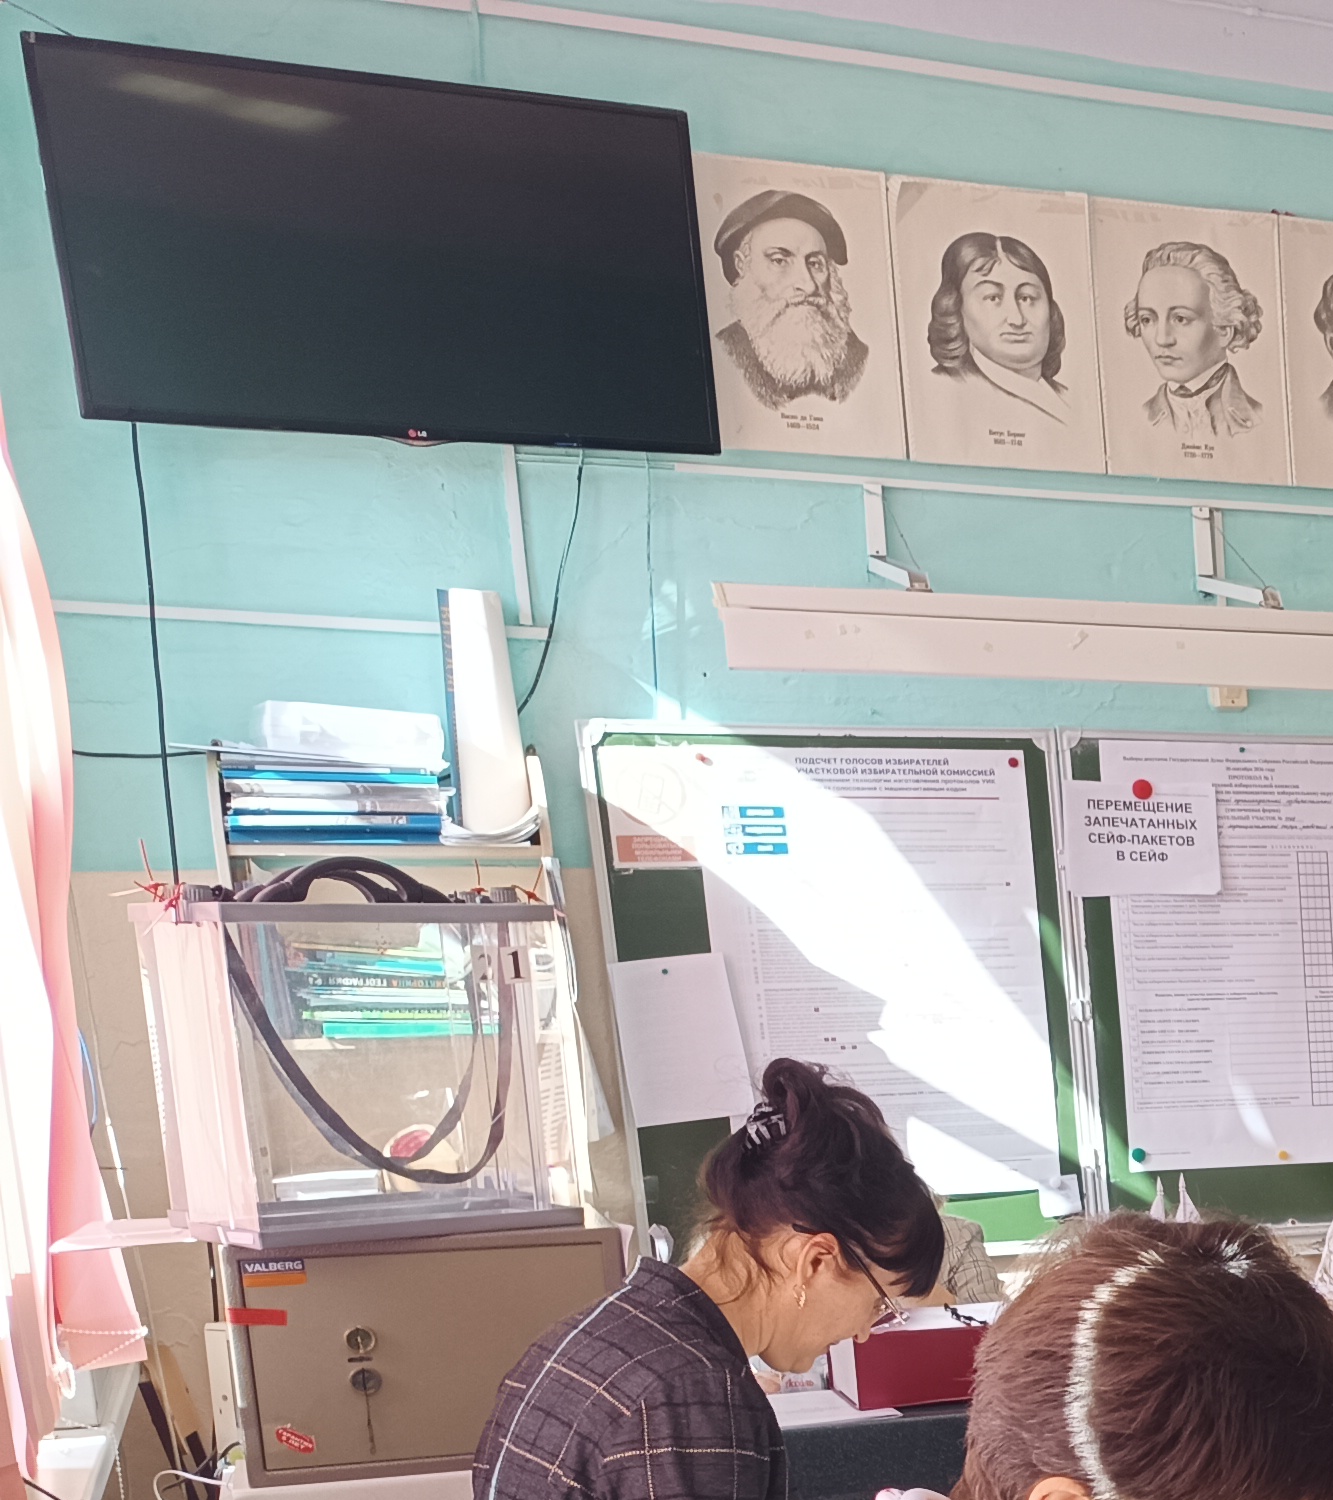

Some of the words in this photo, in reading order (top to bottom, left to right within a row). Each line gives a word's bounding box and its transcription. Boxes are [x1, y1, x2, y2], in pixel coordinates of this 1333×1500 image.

[795, 757, 837, 765] ПОДСЧЕТ
[886, 758, 949, 766] ИЗБИРАТЕЛЕЙ
[797, 767, 858, 775] УЧАСТКОВОЙ
[861, 768, 938, 776] ИЗБИРАТЕЛЬНОЙ
[941, 768, 995, 776] КОМИССИЕЙ
[1087, 799, 1193, 814] ПЕРЕМЕЩЕНИЕ
[1084, 816, 1197, 830] ЗАПЕЧАТАННЫХ
[1088, 832, 1195, 847] СЕЙФ-ПАКЕТОВ
[1116, 851, 1125, 861] В
[1130, 850, 1168, 863] СЕЙФ
[507, 950, 525, 979] 1
[245, 1260, 303, 1273] VALBERG
